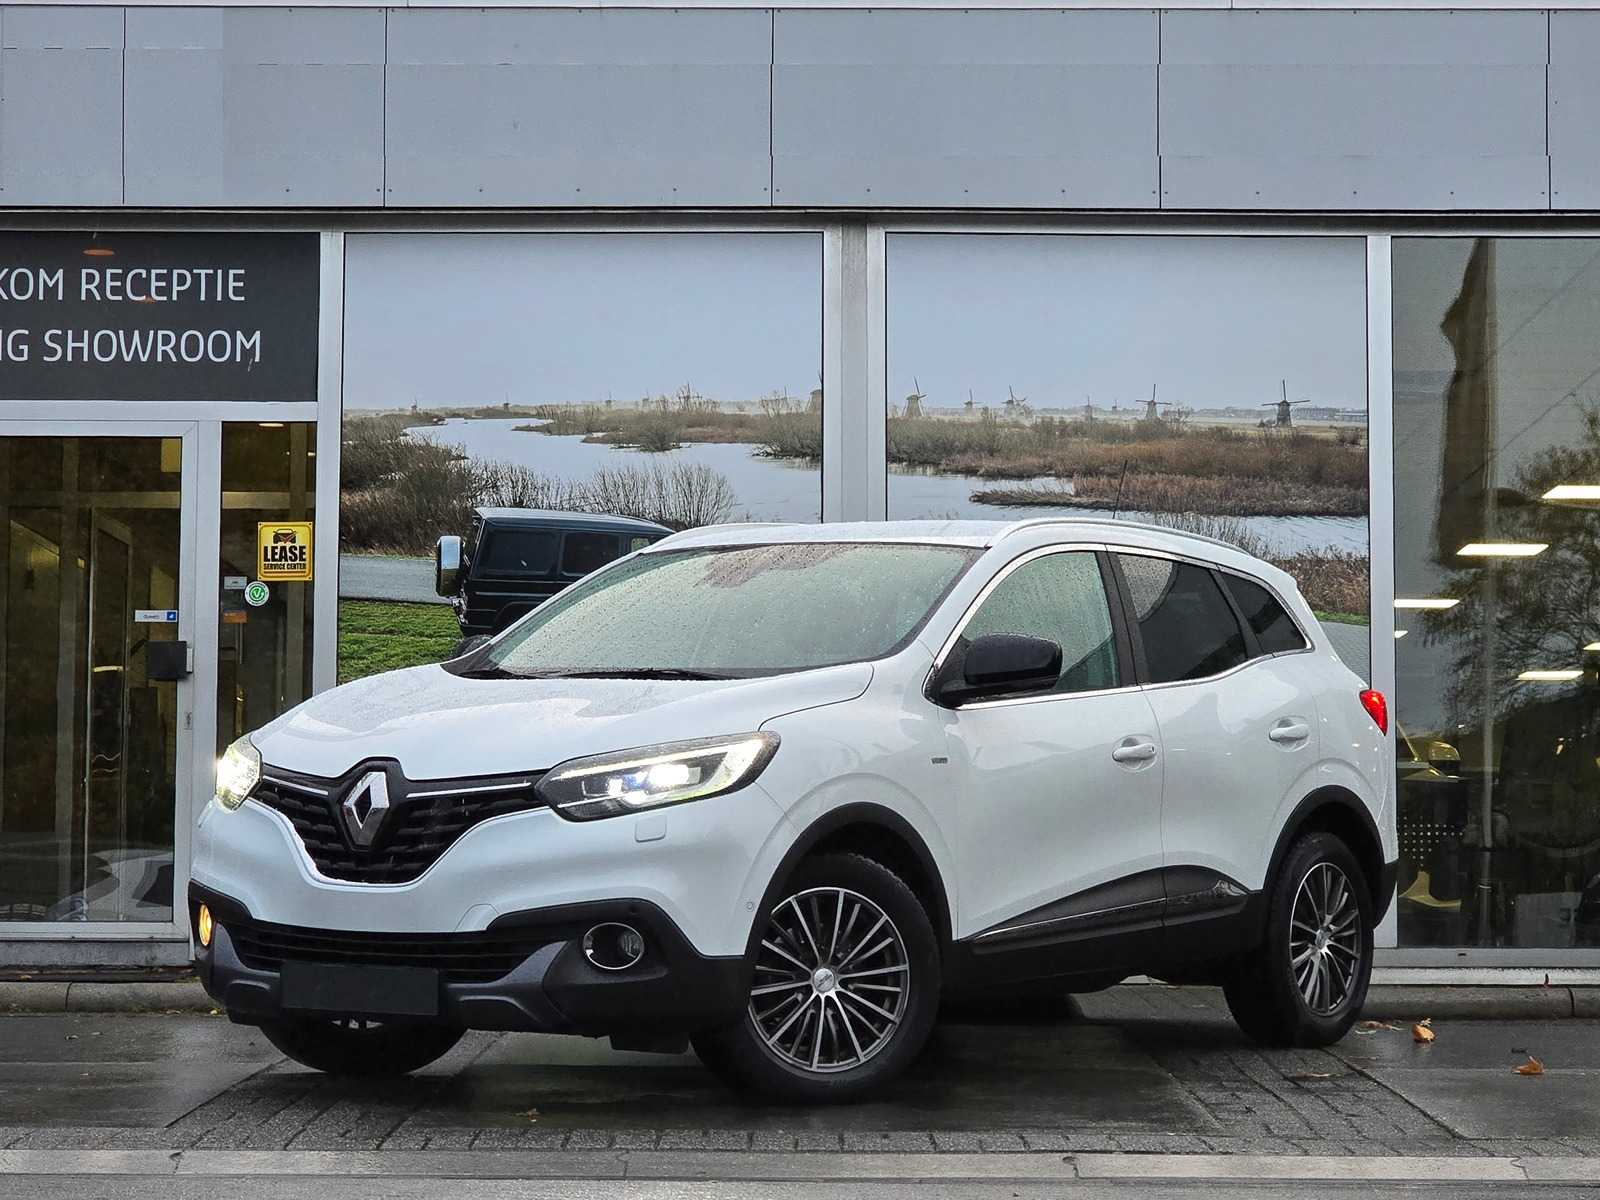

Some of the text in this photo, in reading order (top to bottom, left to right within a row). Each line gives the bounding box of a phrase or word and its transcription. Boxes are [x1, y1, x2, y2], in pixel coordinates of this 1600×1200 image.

[80, 268, 246, 301] RECEPTIE
[0, 329, 261, 363] G SHOWROOM
[263, 545, 307, 563] LEASE
[263, 562, 307, 570] SERVICE CENTER
